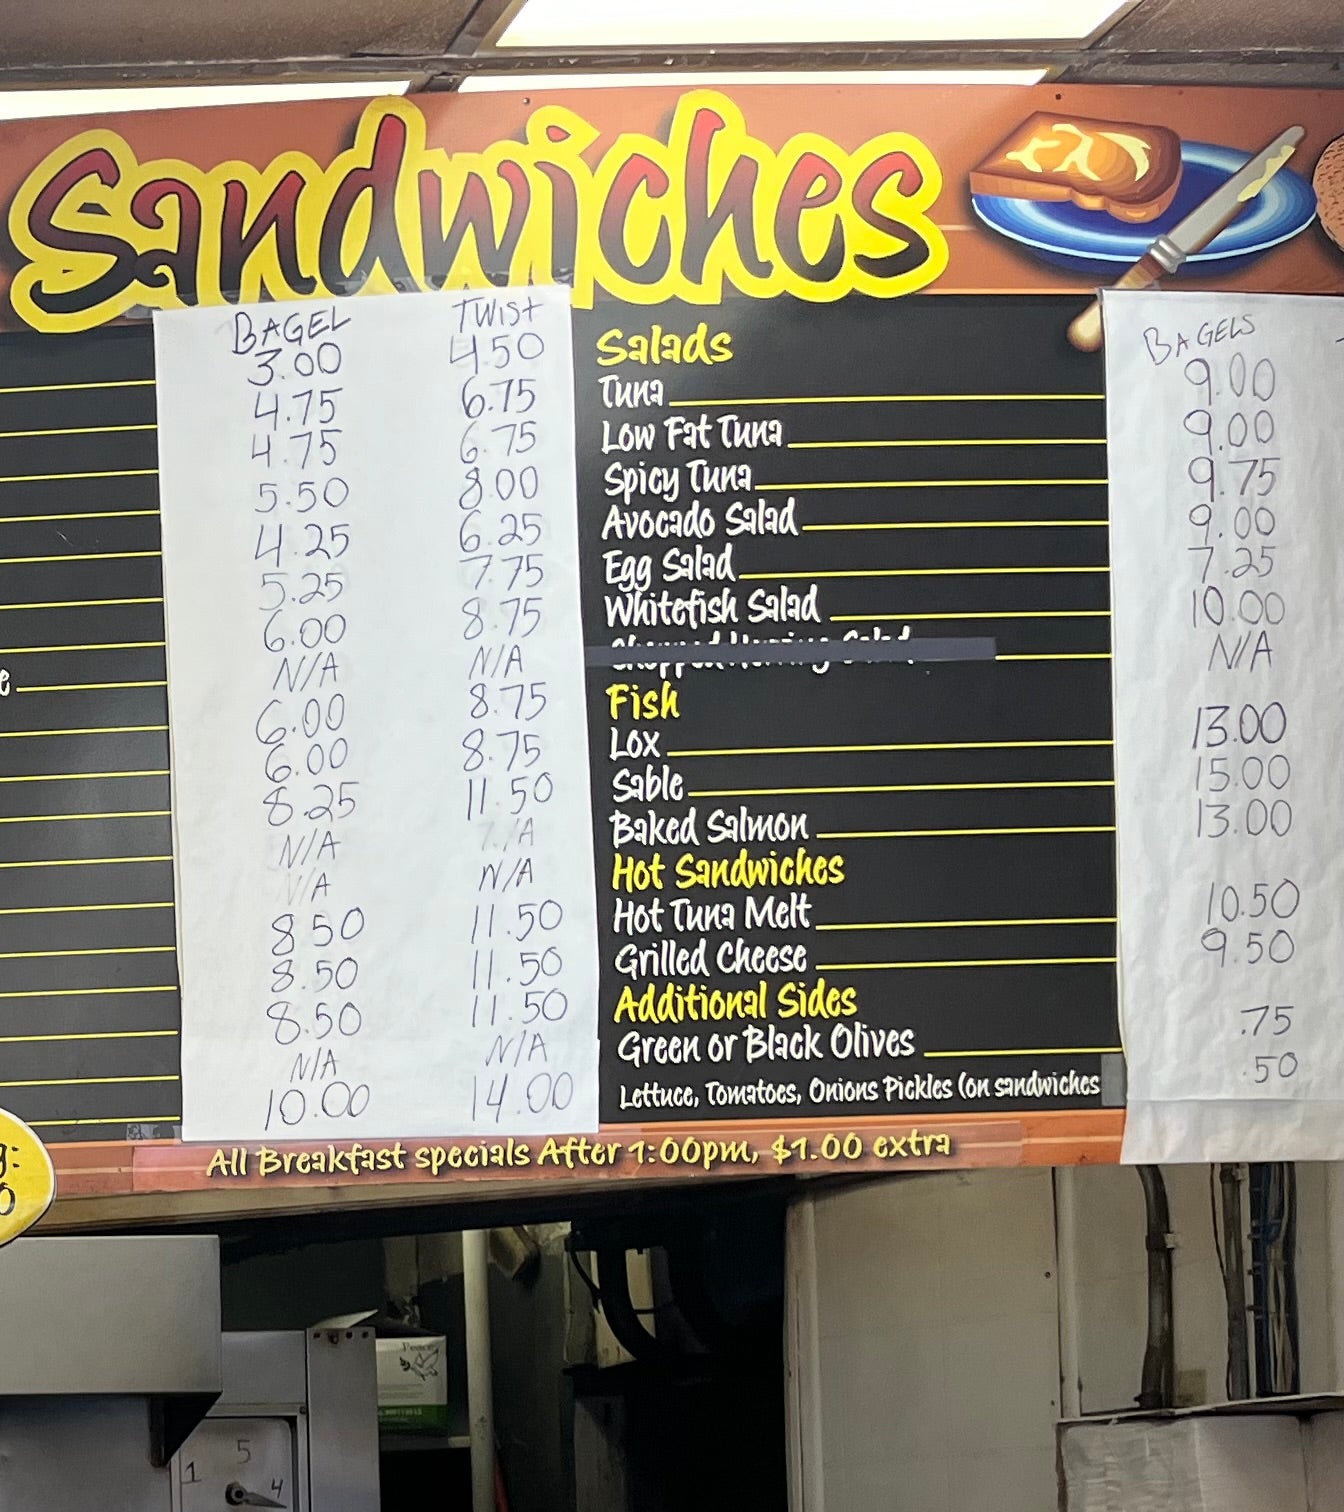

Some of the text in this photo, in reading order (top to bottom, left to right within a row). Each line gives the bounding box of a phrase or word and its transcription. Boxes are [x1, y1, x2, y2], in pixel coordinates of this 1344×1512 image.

[20, 97, 934, 325] Sandwiches
[232, 304, 352, 355] BAGEL
[595, 326, 735, 367] Salads
[247, 341, 342, 386] 3.00
[449, 332, 545, 375] 4.50
[598, 373, 664, 410] Tuna
[1192, 585, 1286, 629] 10.00
[606, 682, 680, 722] Fish
[609, 727, 662, 761] Lox
[1192, 701, 1287, 750] 13.00
[609, 805, 809, 848] Baked Salmon
[1201, 927, 1295, 968] 9.50
[473, 987, 569, 1028] 11.50
[614, 979, 858, 1025] Additional Sides
[617, 1019, 916, 1066] Green or Black Olives
[265, 1081, 371, 1131] 10.00
[182, 1461, 202, 1485] 1
[236, 1439, 251, 1464] 5
[271, 1478, 284, 1499] 4
